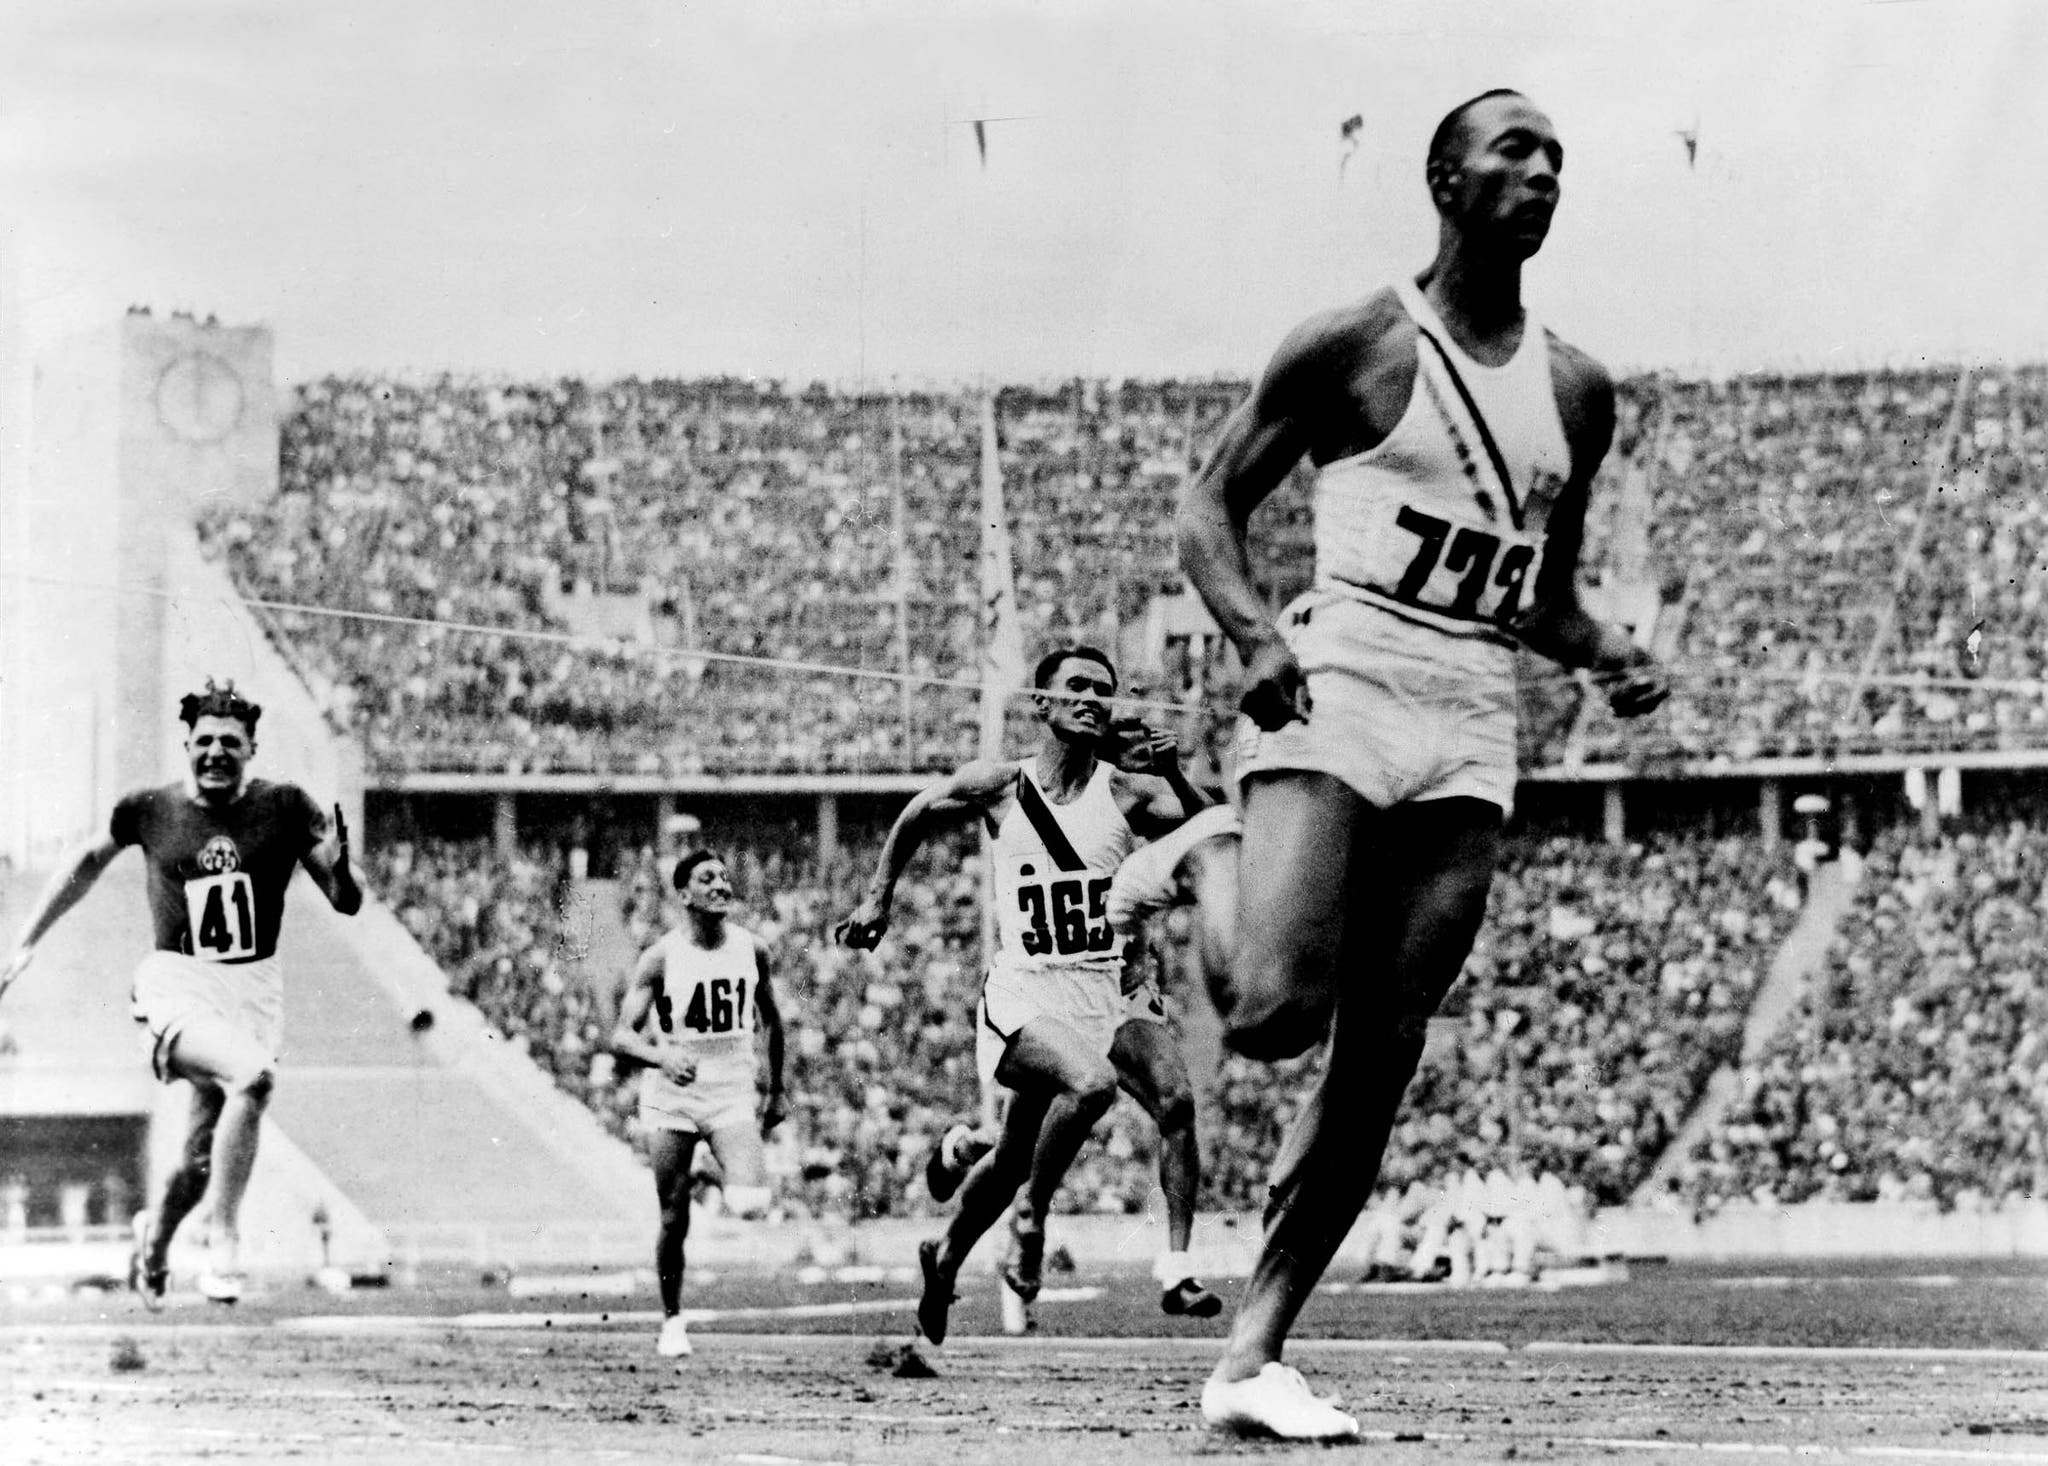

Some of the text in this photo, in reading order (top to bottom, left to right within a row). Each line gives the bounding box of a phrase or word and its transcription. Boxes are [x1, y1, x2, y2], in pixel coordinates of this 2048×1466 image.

[199, 880, 252, 952] 41
[1018, 877, 1114, 956] 365
[685, 978, 746, 1033] 461
